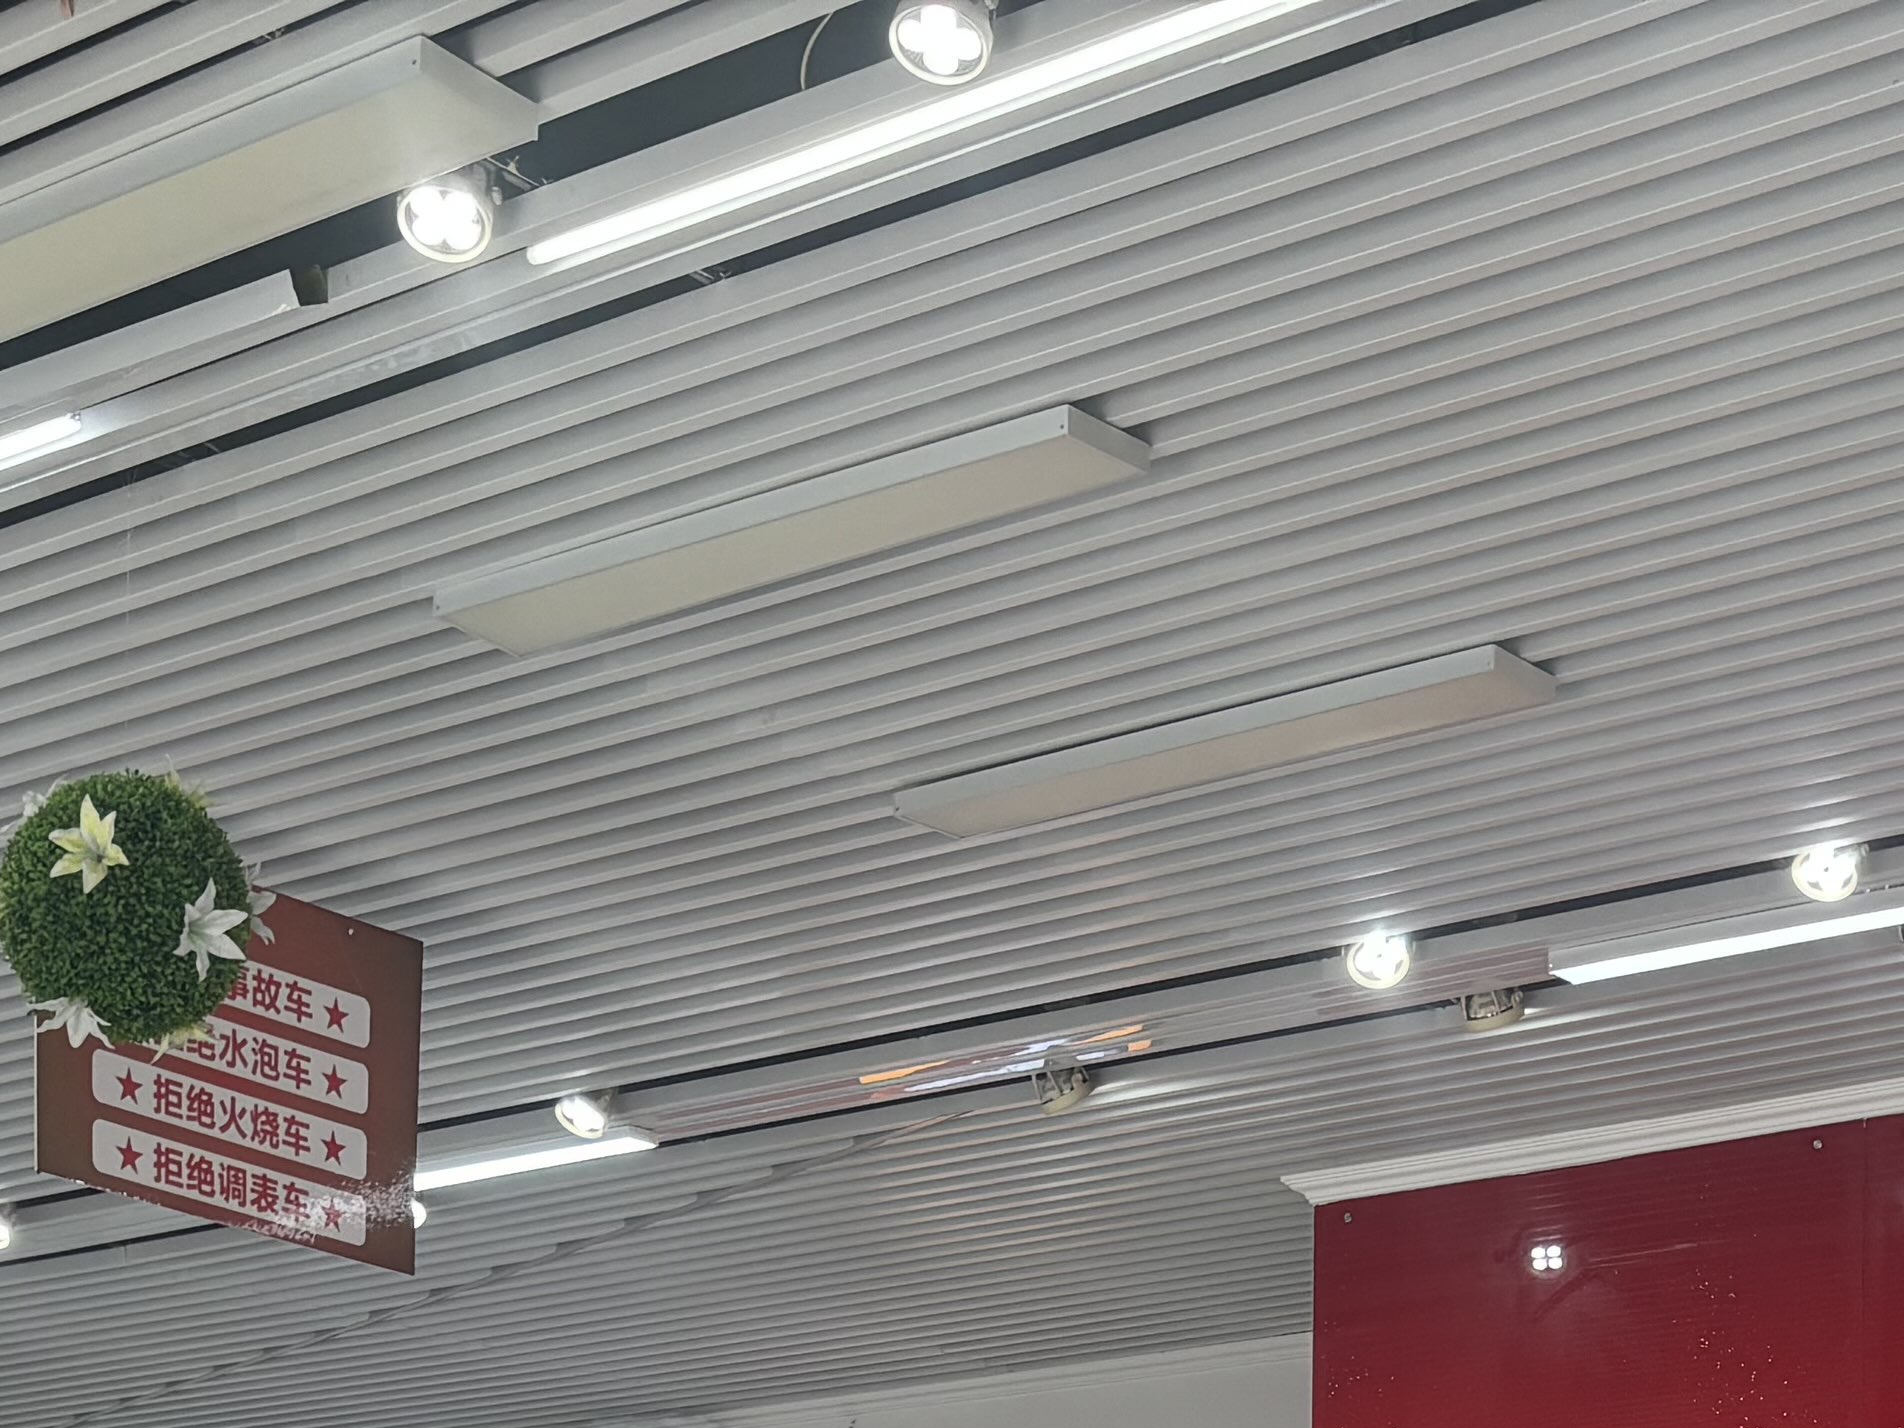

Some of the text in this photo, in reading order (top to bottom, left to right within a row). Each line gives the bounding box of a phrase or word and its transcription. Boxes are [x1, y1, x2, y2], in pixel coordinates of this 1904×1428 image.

[226, 967, 313, 1023] 事故车
[169, 1031, 313, 1089] 绝水泡车
[154, 1074, 311, 1157] 拒绝火烧车
[154, 1143, 311, 1224] 拒绝调表车
